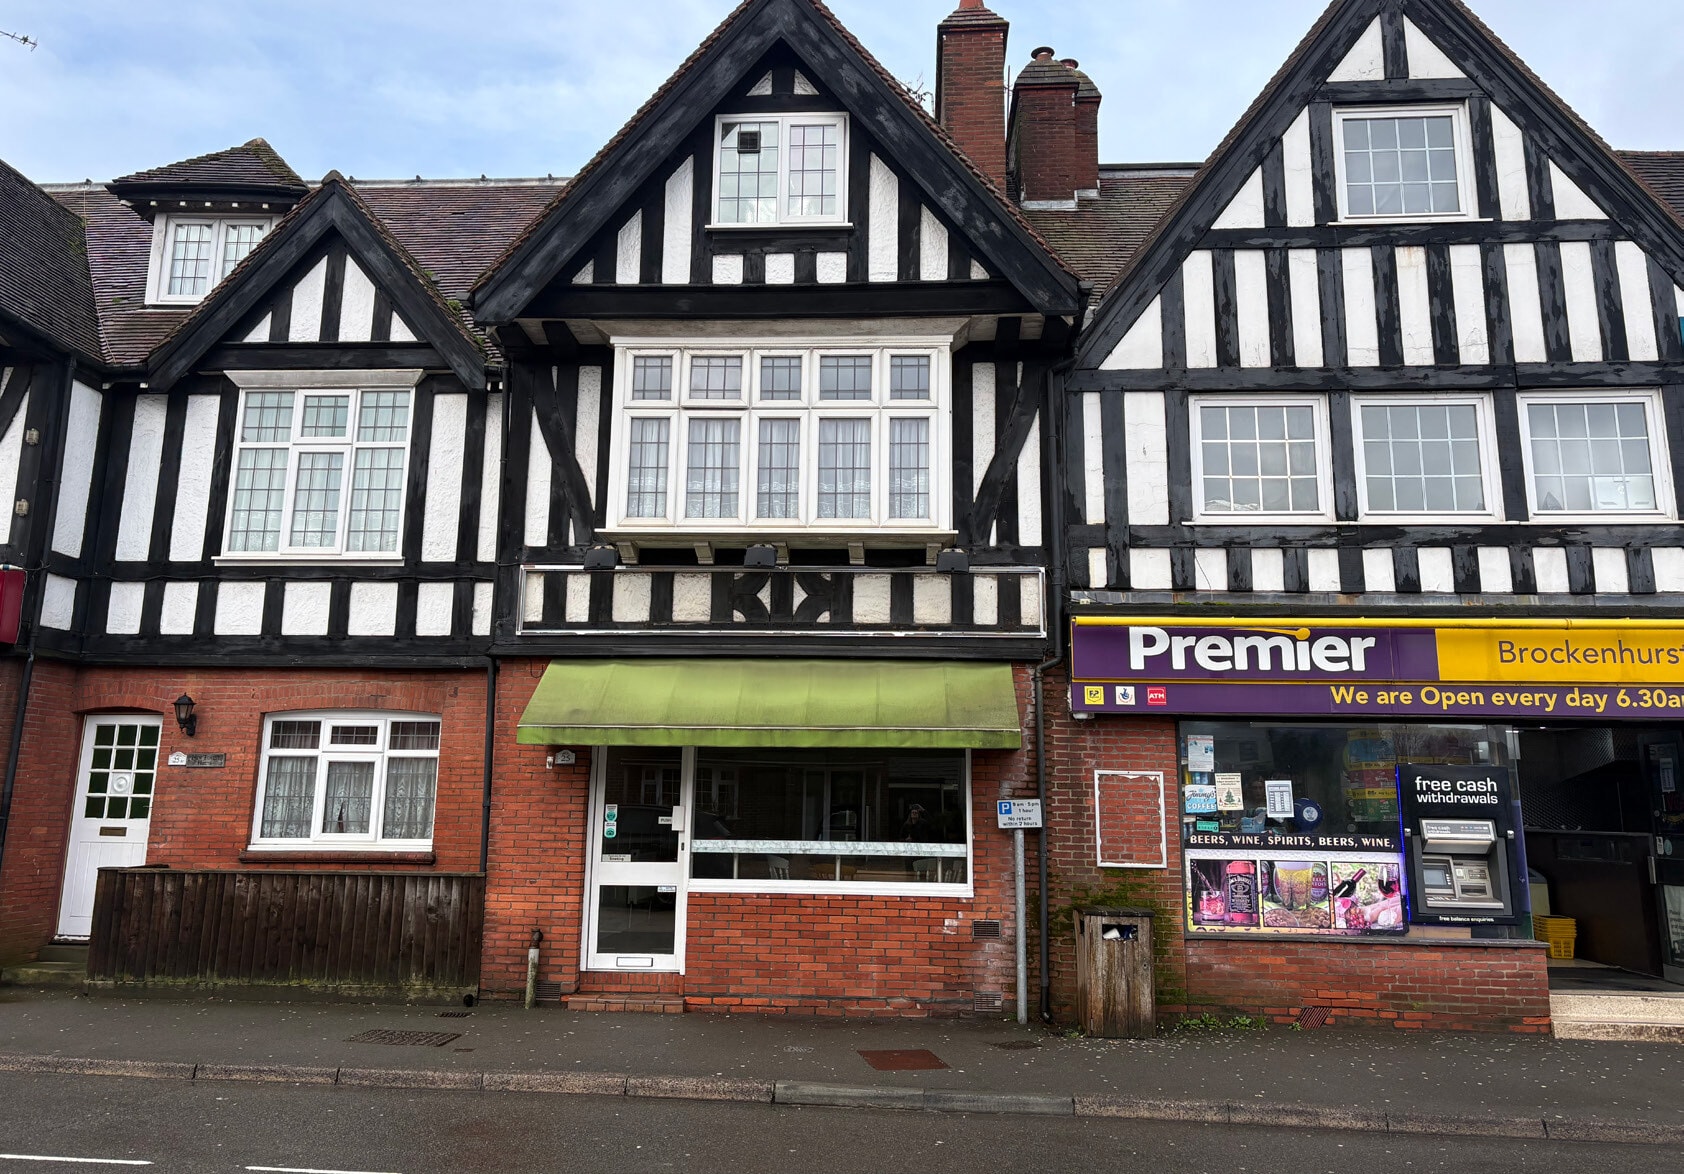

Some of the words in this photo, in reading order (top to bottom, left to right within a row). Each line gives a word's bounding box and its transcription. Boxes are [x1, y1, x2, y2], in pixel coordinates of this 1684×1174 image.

[1128, 626, 1376, 671] Premier
[1330, 686, 1369, 704] We
[1376, 690, 1413, 705] are
[1420, 686, 1485, 710] Open
[1491, 691, 1558, 712] every
[1565, 687, 1608, 713] day
[1616, 688, 1684, 708] 6.30a
[1415, 776, 1452, 791] free
[1456, 777, 1498, 792] cash
[1416, 791, 1499, 804] withdrawals
[1002, 803, 1010, 814] P
[1190, 835, 1229, 846] BEERS,
[1232, 835, 1264, 846] WINE,
[1267, 836, 1315, 847] SPIRITS,
[1318, 837, 1358, 848] BEERS,
[1361, 837, 1395, 849] WINE,
